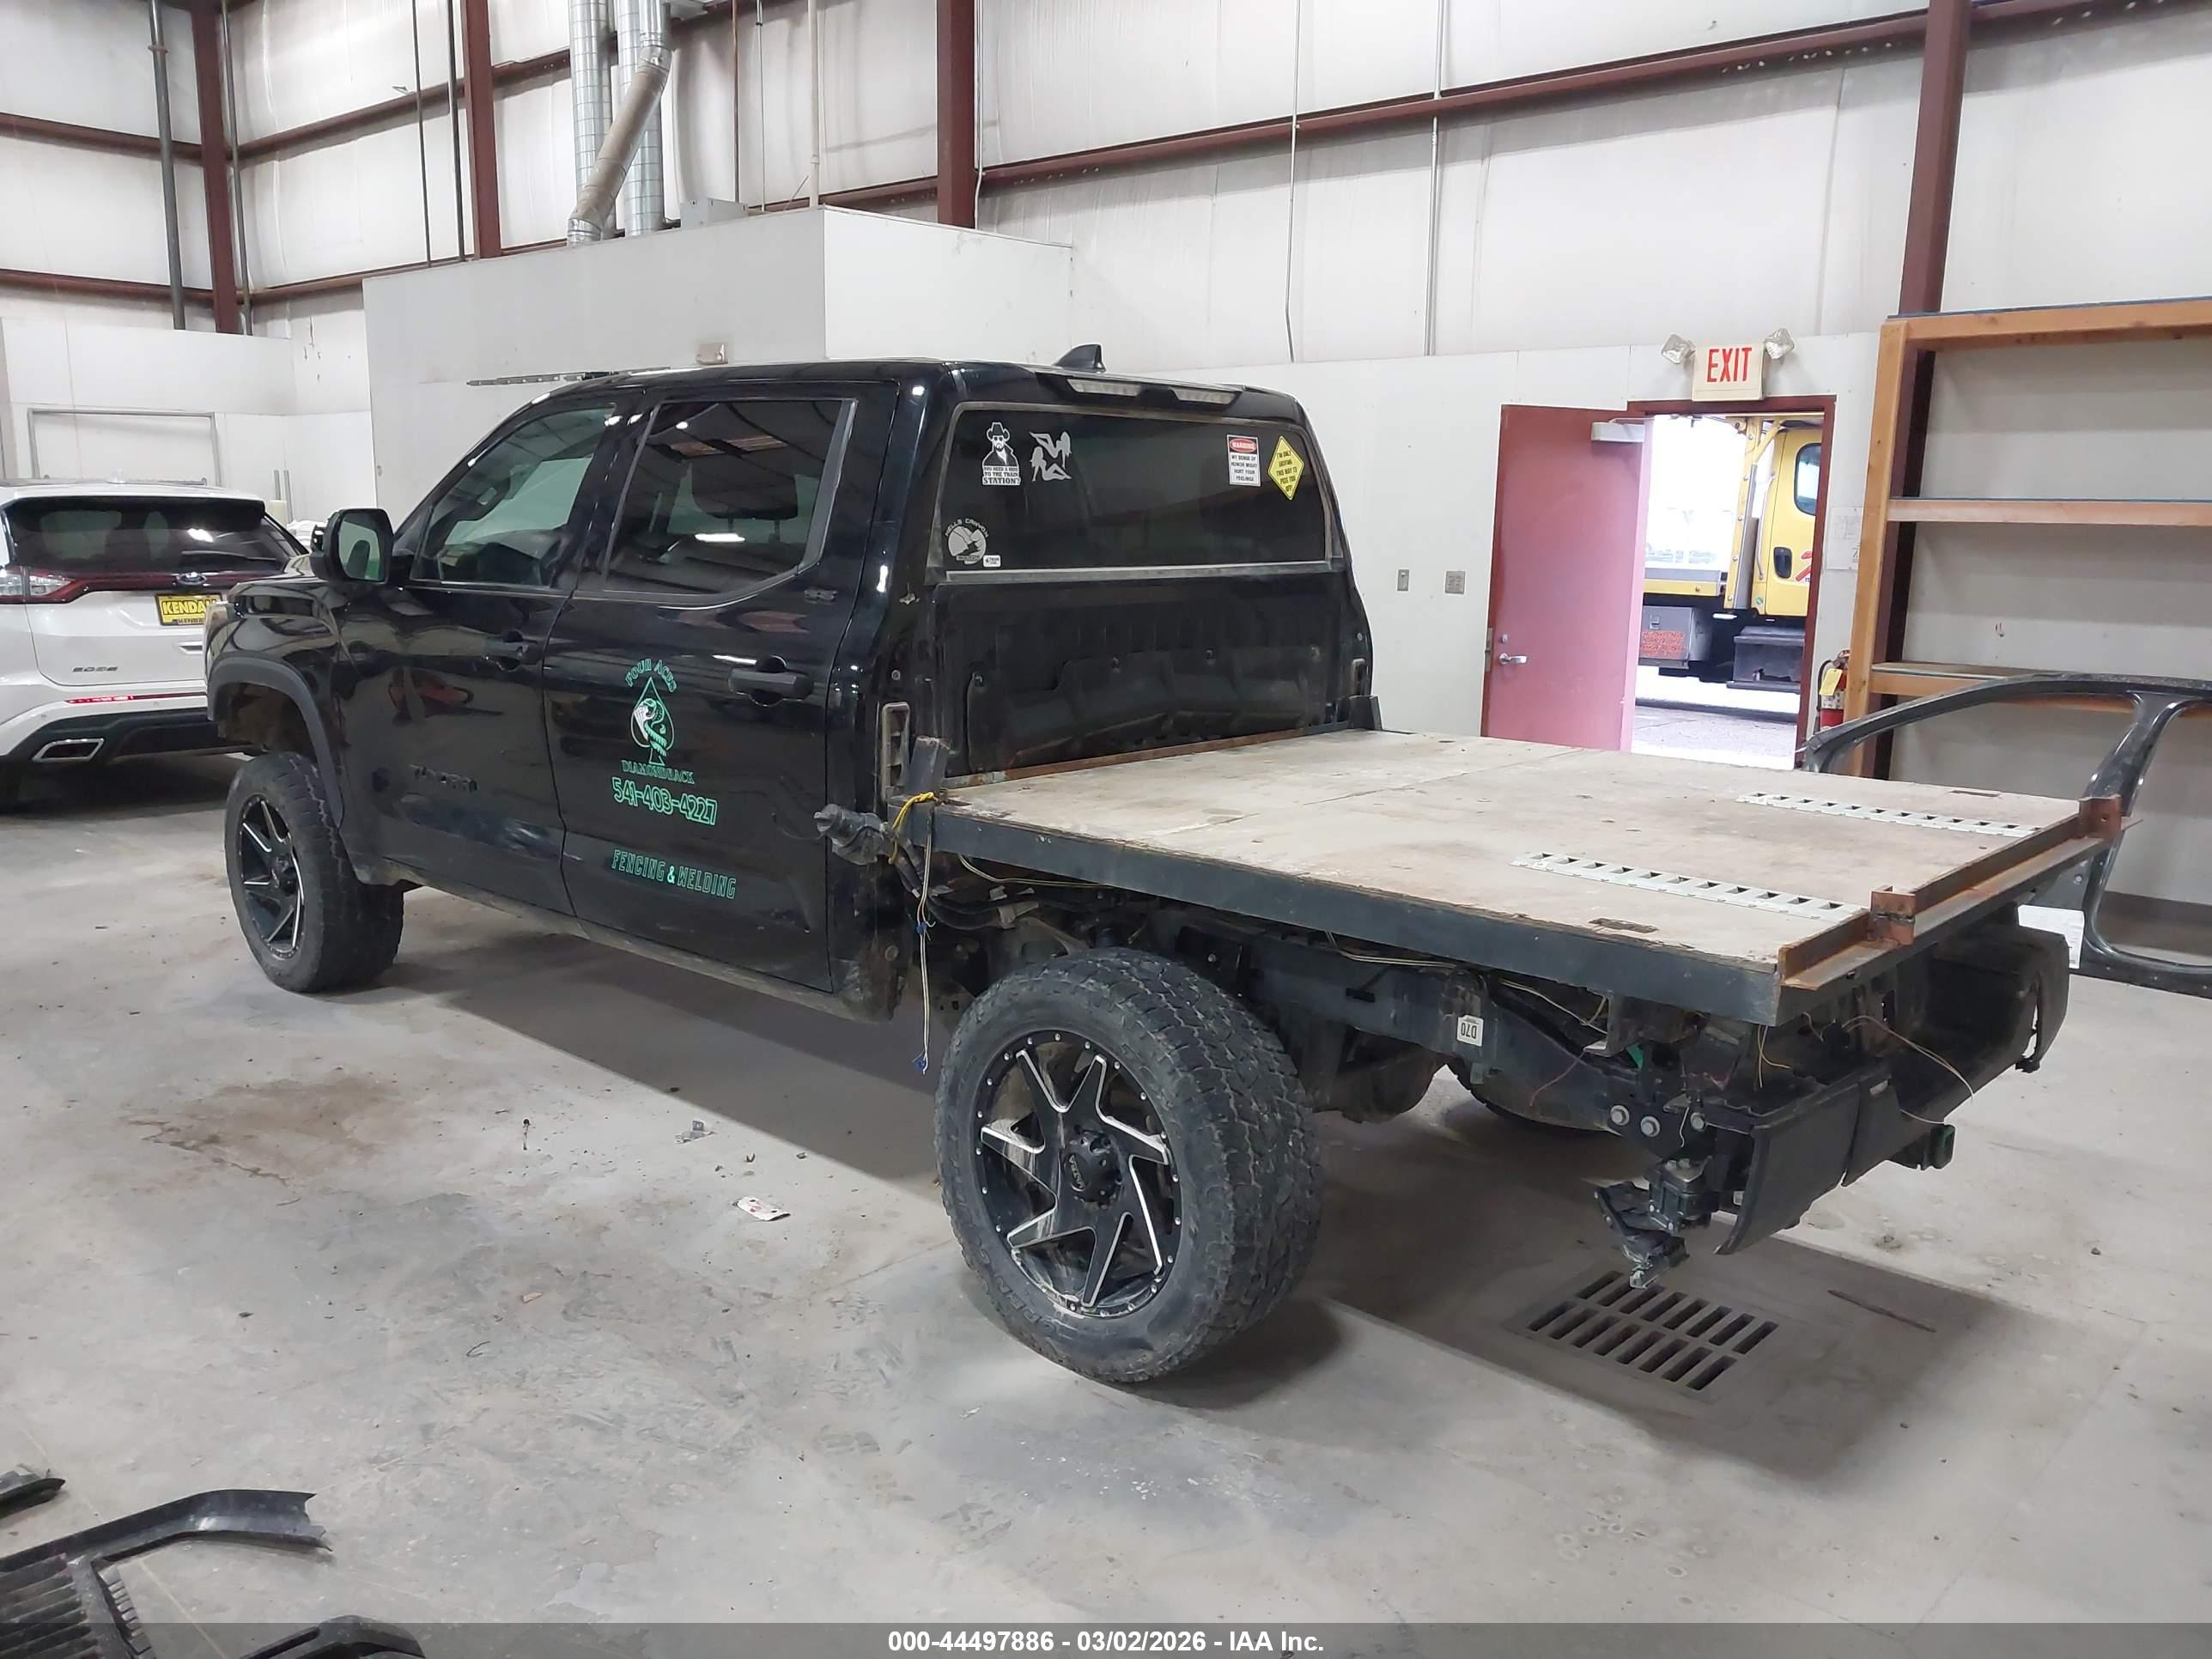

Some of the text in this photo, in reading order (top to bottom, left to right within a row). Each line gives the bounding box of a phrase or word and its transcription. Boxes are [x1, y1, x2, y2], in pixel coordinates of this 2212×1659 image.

[1706, 347, 1753, 382] EXIT
[161, 599, 217, 615] KENDA
[625, 659, 653, 687] FOUR
[611, 776, 718, 826] 541-403-4227
[611, 849, 737, 899] FENCING & WELDING
[1461, 1022, 1478, 1039] D70
